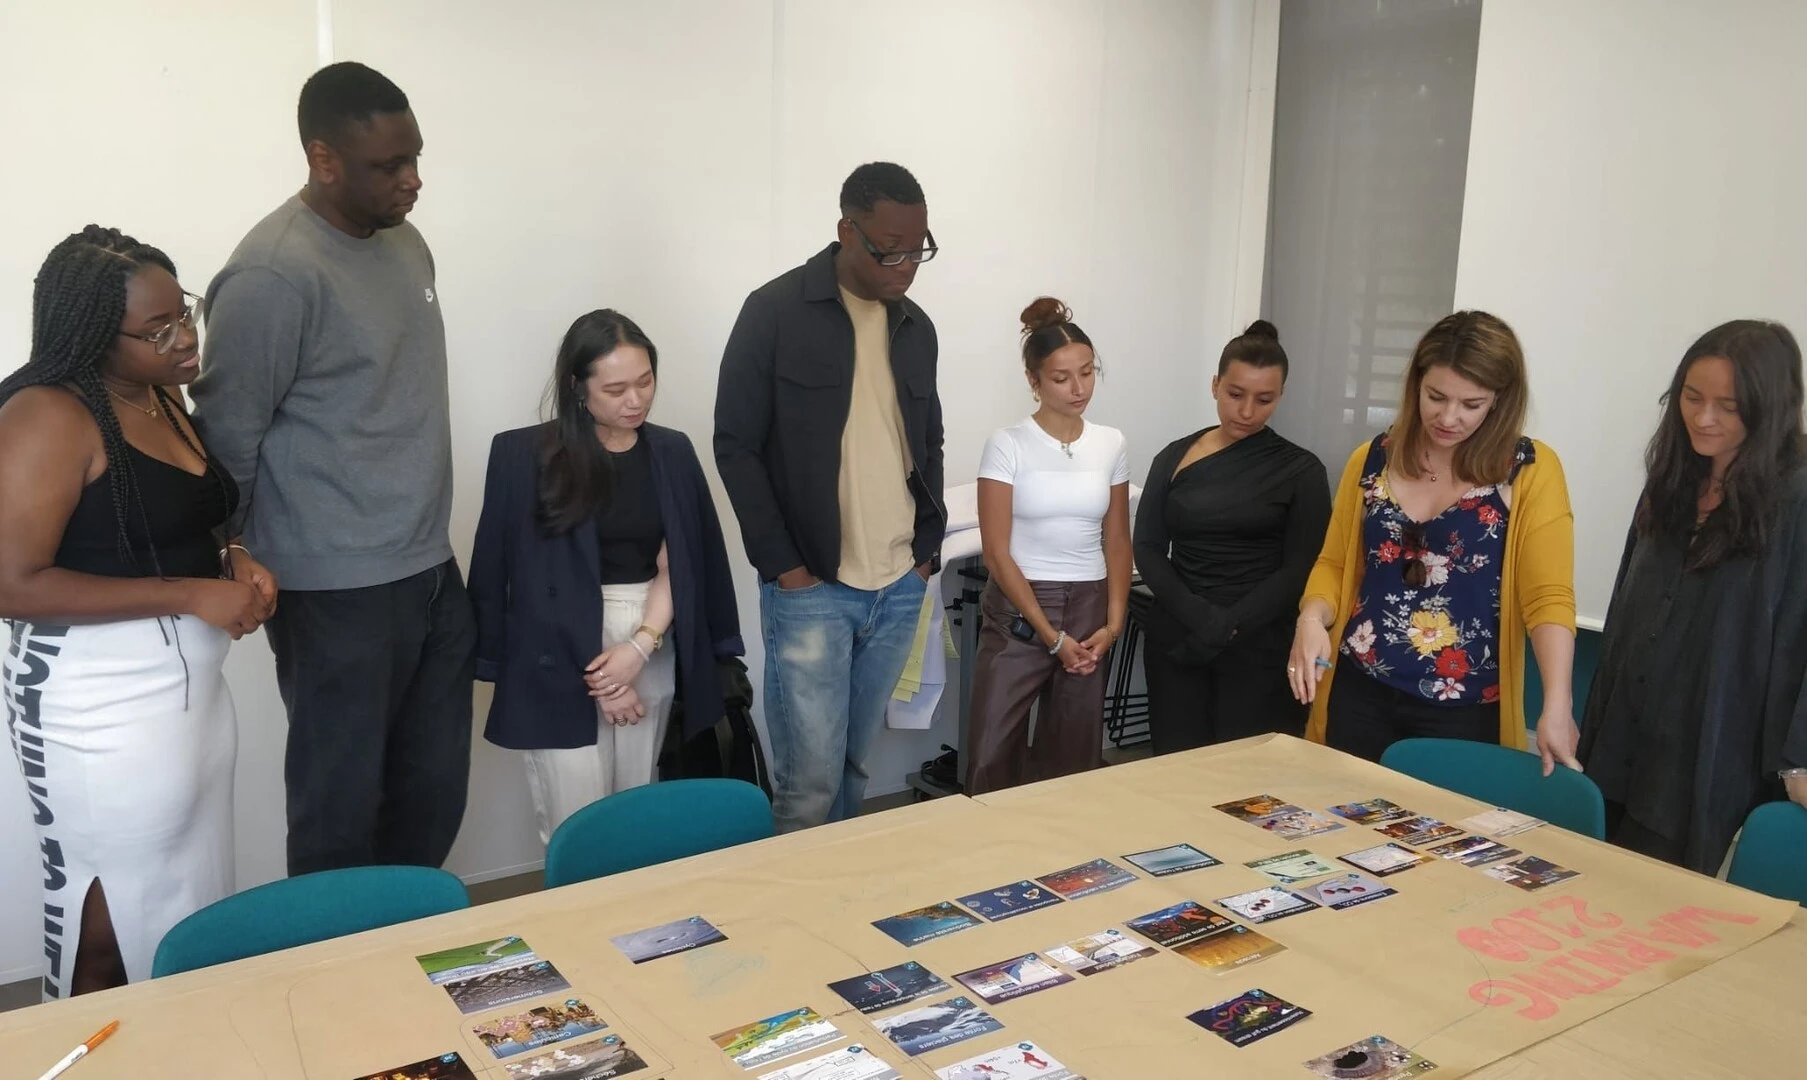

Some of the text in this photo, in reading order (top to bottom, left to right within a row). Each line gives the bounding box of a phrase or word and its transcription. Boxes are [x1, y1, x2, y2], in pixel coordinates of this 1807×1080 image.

[1456, 896, 1622, 962] 2100
[661, 942, 696, 956] Cyclones
[1468, 905, 1760, 1021] WARNING
[1040, 978, 1059, 988] Bilan
[488, 989, 544, 1006] Submersions
[918, 1024, 988, 1051] Fonte des glaciers
